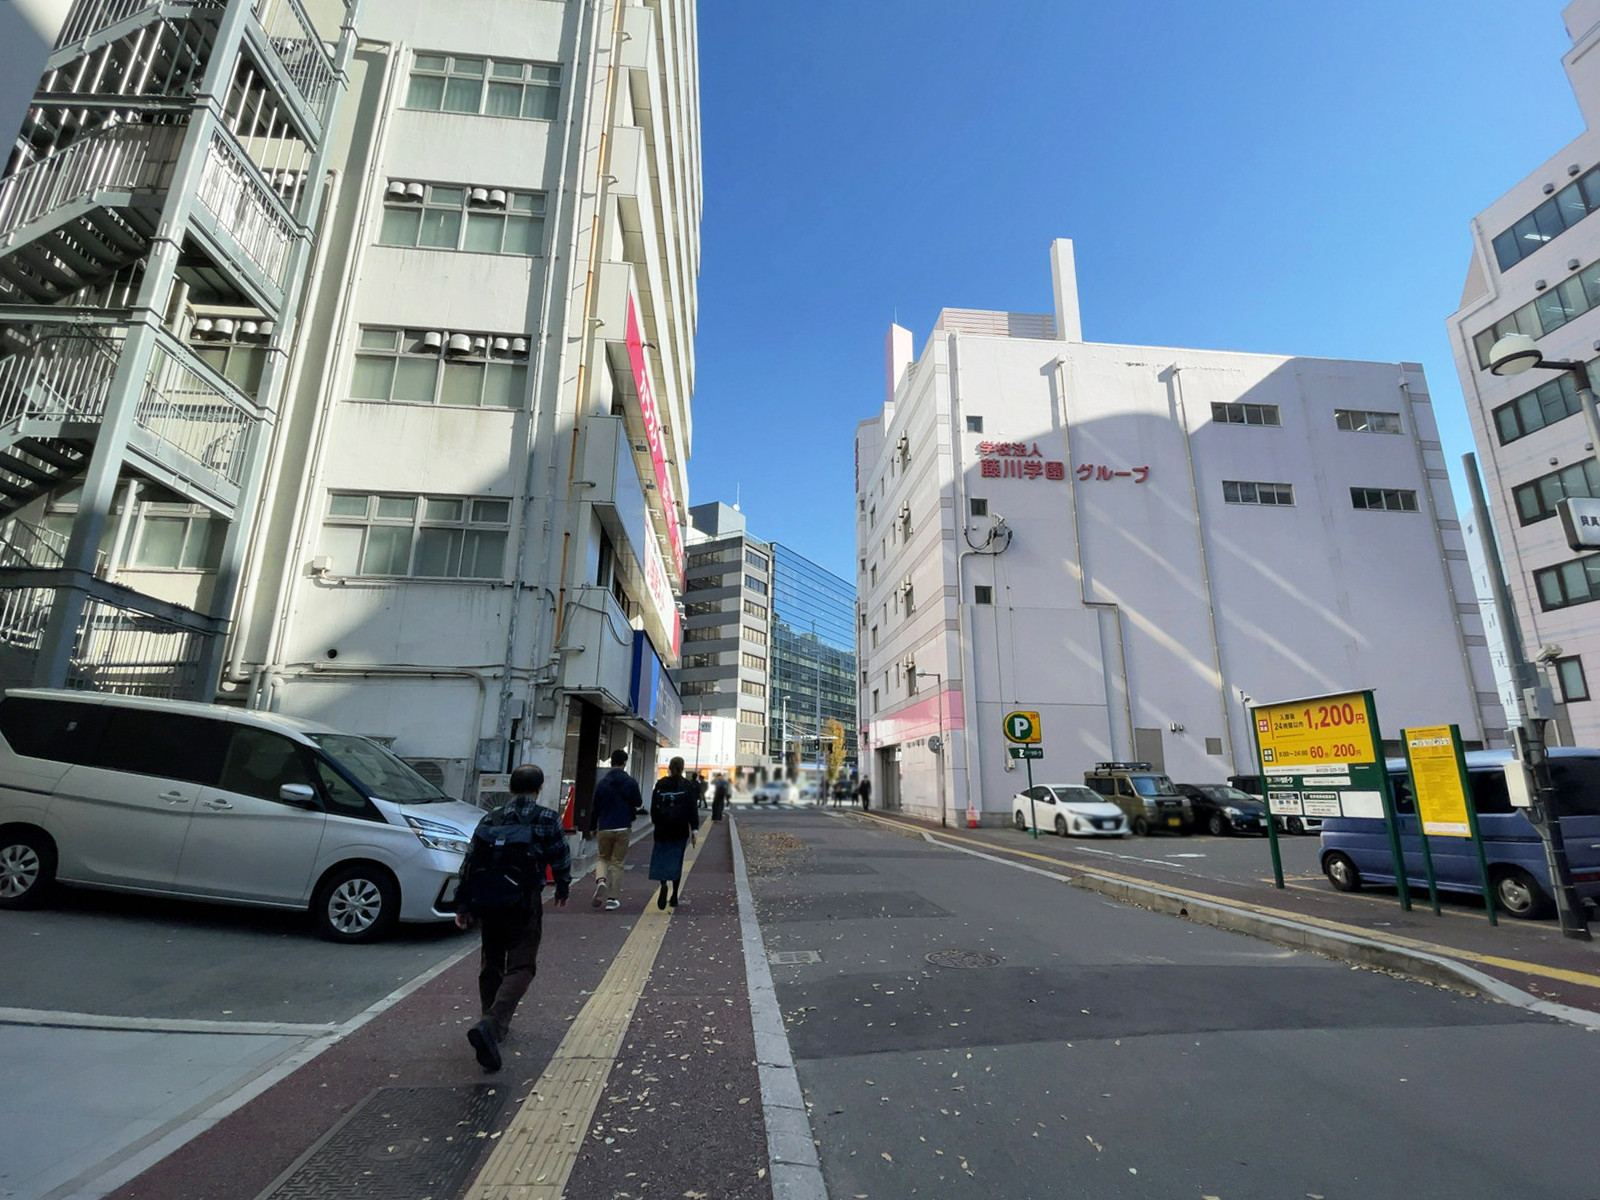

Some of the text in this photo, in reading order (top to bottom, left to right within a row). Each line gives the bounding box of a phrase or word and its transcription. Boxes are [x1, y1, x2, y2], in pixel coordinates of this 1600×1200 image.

[980, 441, 1043, 458] 学校法人
[1077, 464, 1149, 483] グループ
[1014, 718, 1029, 737] P
